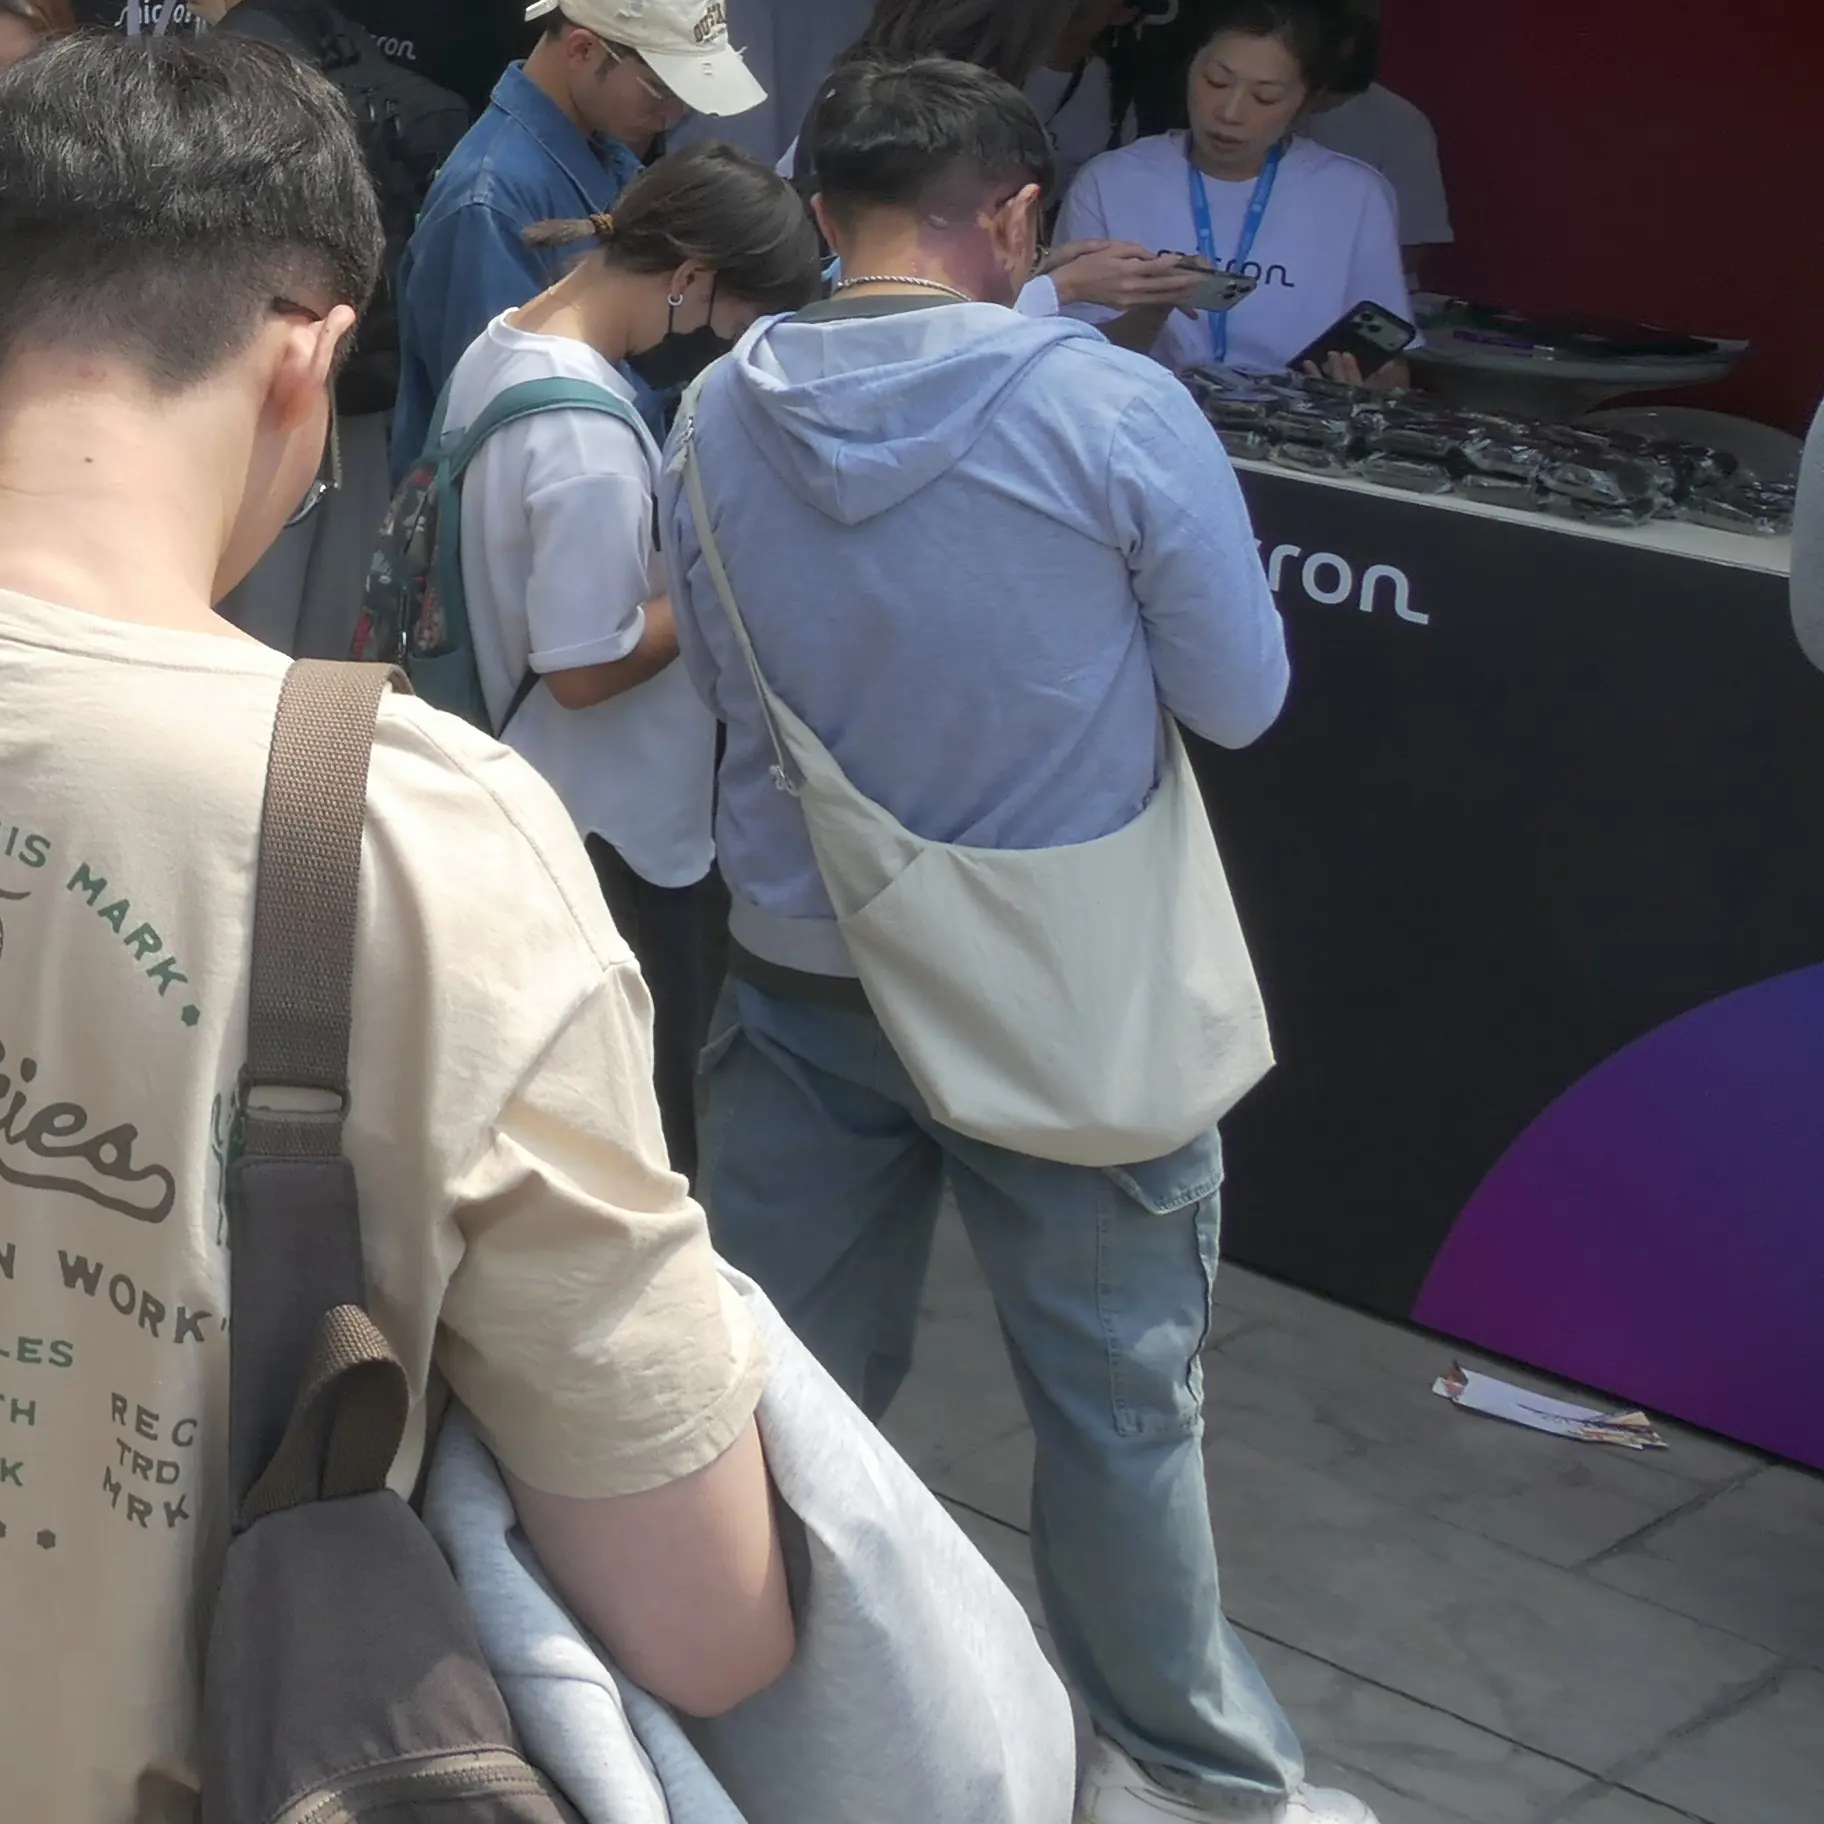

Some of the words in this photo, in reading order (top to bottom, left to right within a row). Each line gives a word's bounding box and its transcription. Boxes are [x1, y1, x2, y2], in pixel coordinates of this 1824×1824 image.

[66, 862, 190, 997] MARK
[113, 1436, 183, 1486] TRD
[102, 1467, 191, 1531] MRK
